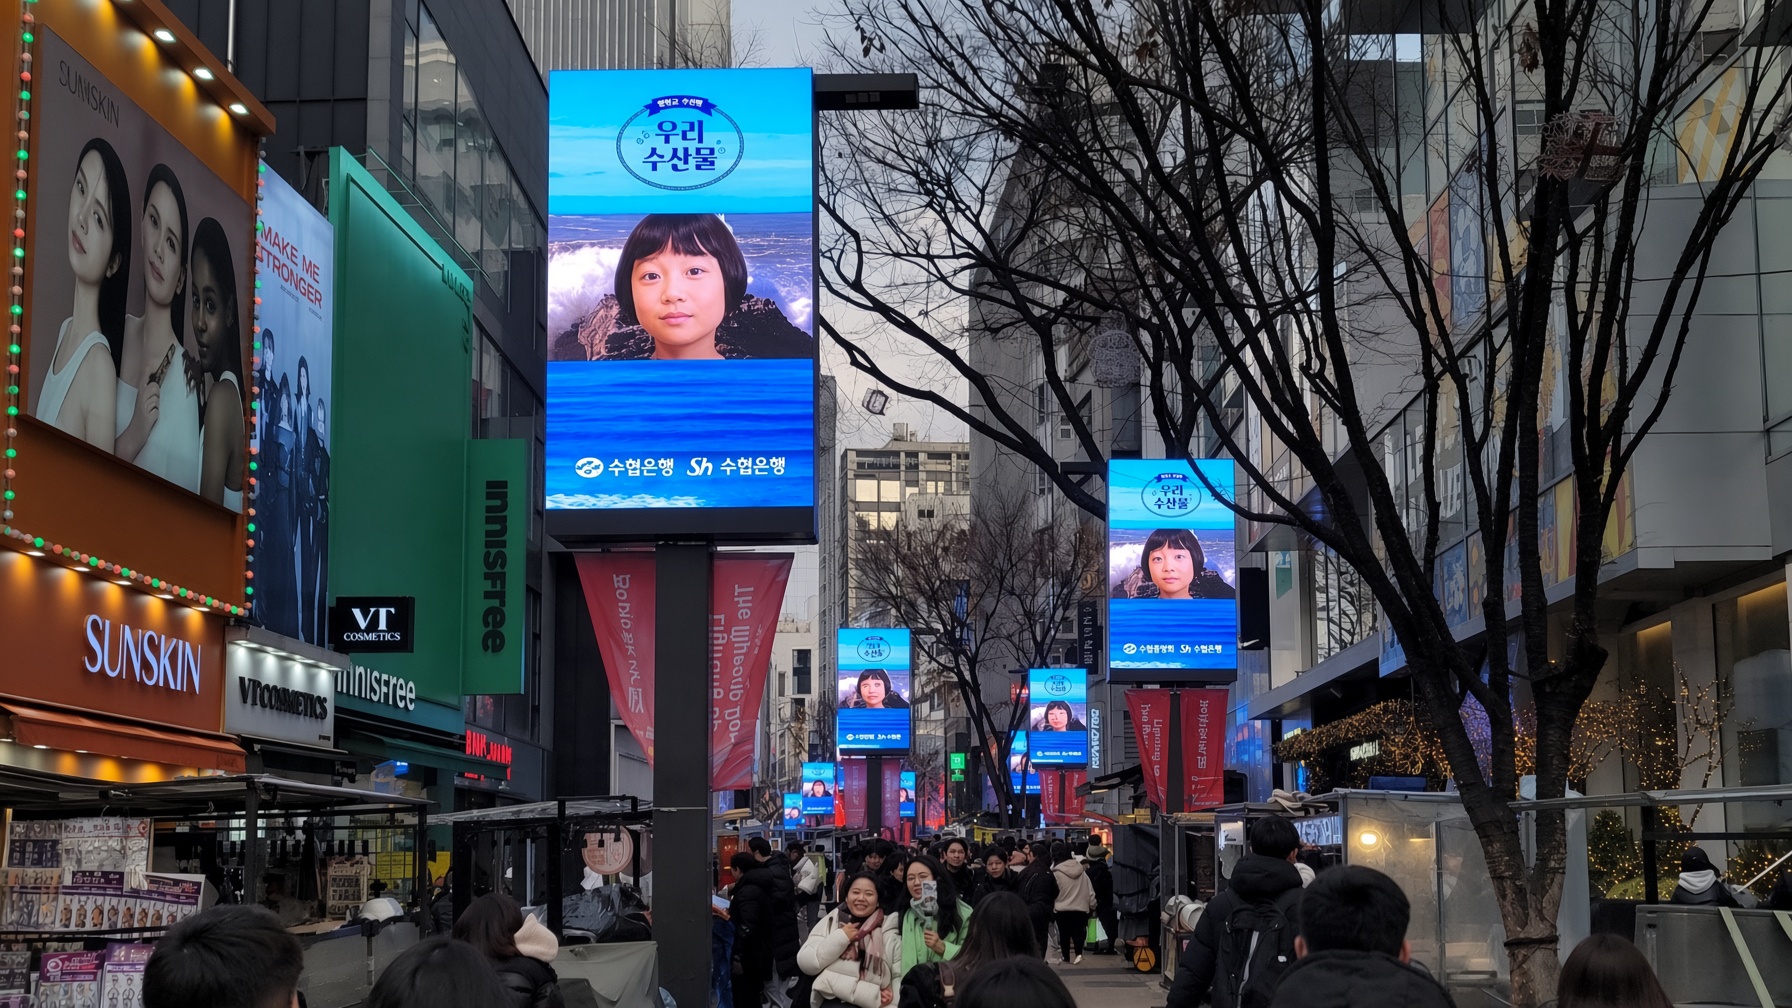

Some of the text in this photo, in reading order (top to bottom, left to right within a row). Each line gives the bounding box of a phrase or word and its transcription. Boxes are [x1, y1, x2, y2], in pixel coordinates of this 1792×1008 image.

[655, 119, 704, 144] 우리
[642, 146, 718, 172] 수산물
[260, 221, 320, 285] MAKE ME
[608, 456, 786, 477] 수협은행 Sh 수협은행
[1160, 484, 1183, 497] 우리
[1153, 497, 1189, 510] 수산물
[351, 607, 395, 630] VT
[343, 632, 401, 642] COSMETICS
[84, 614, 201, 695] SUNSKIN
